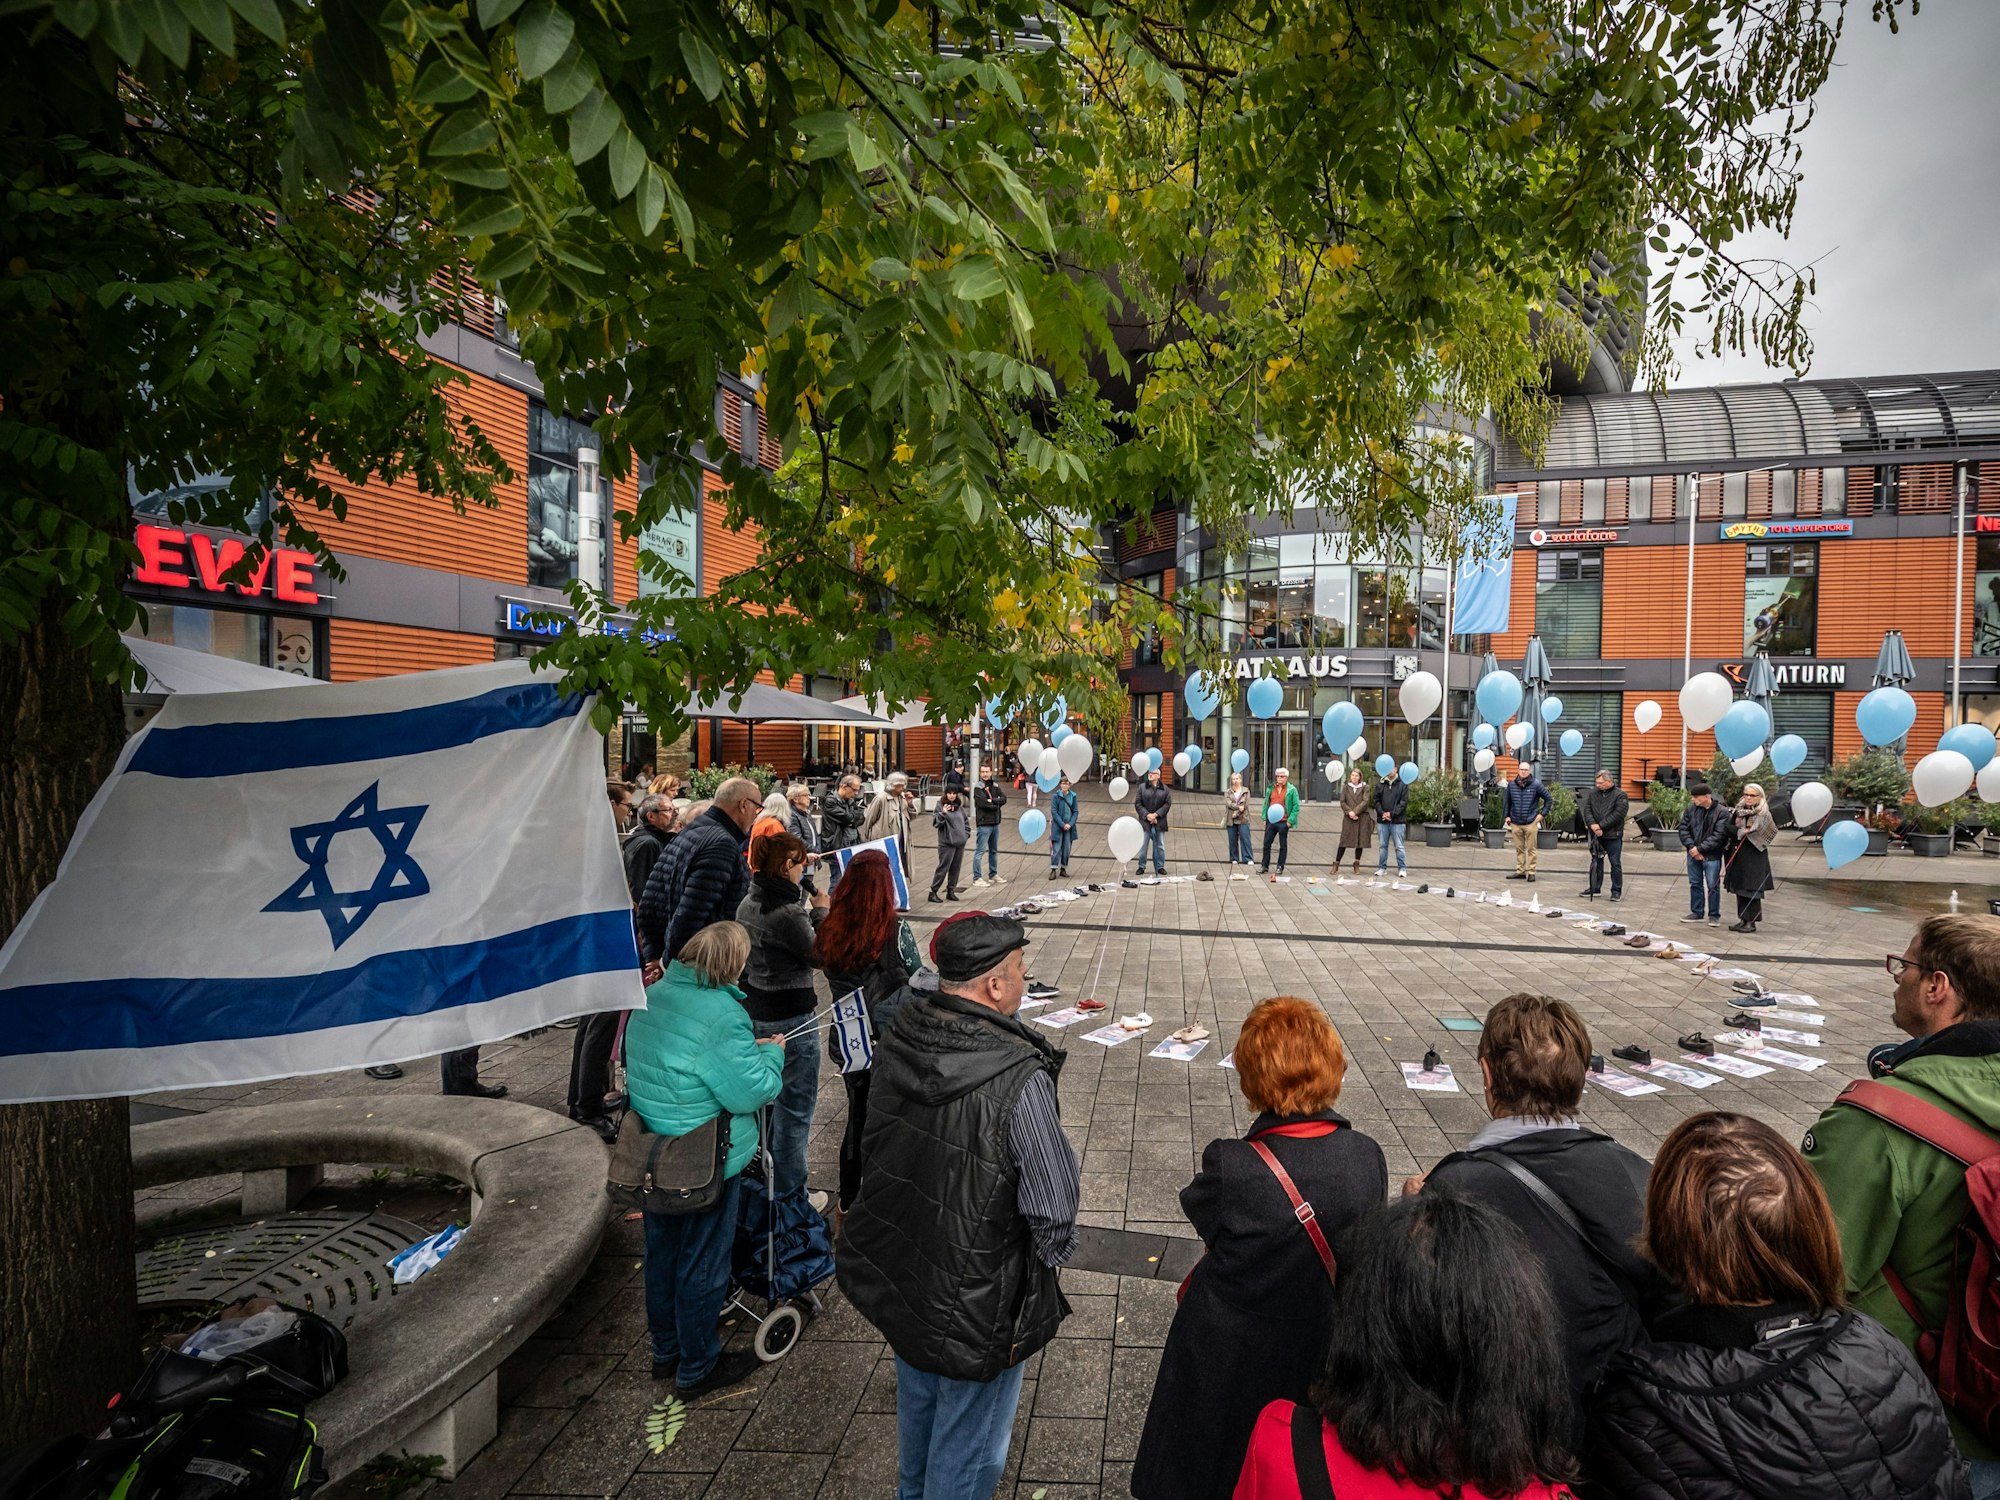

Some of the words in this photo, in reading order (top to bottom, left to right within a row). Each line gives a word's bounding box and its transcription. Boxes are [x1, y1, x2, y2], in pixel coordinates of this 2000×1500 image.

[1551, 529, 1617, 543] vodafone
[1725, 523, 1768, 537] SMYTHS
[1769, 525, 1791, 533] TOYS
[1793, 523, 1850, 533] SUPERSTORES
[135, 524, 318, 605] EWE
[1771, 664, 1845, 684] ATURN
